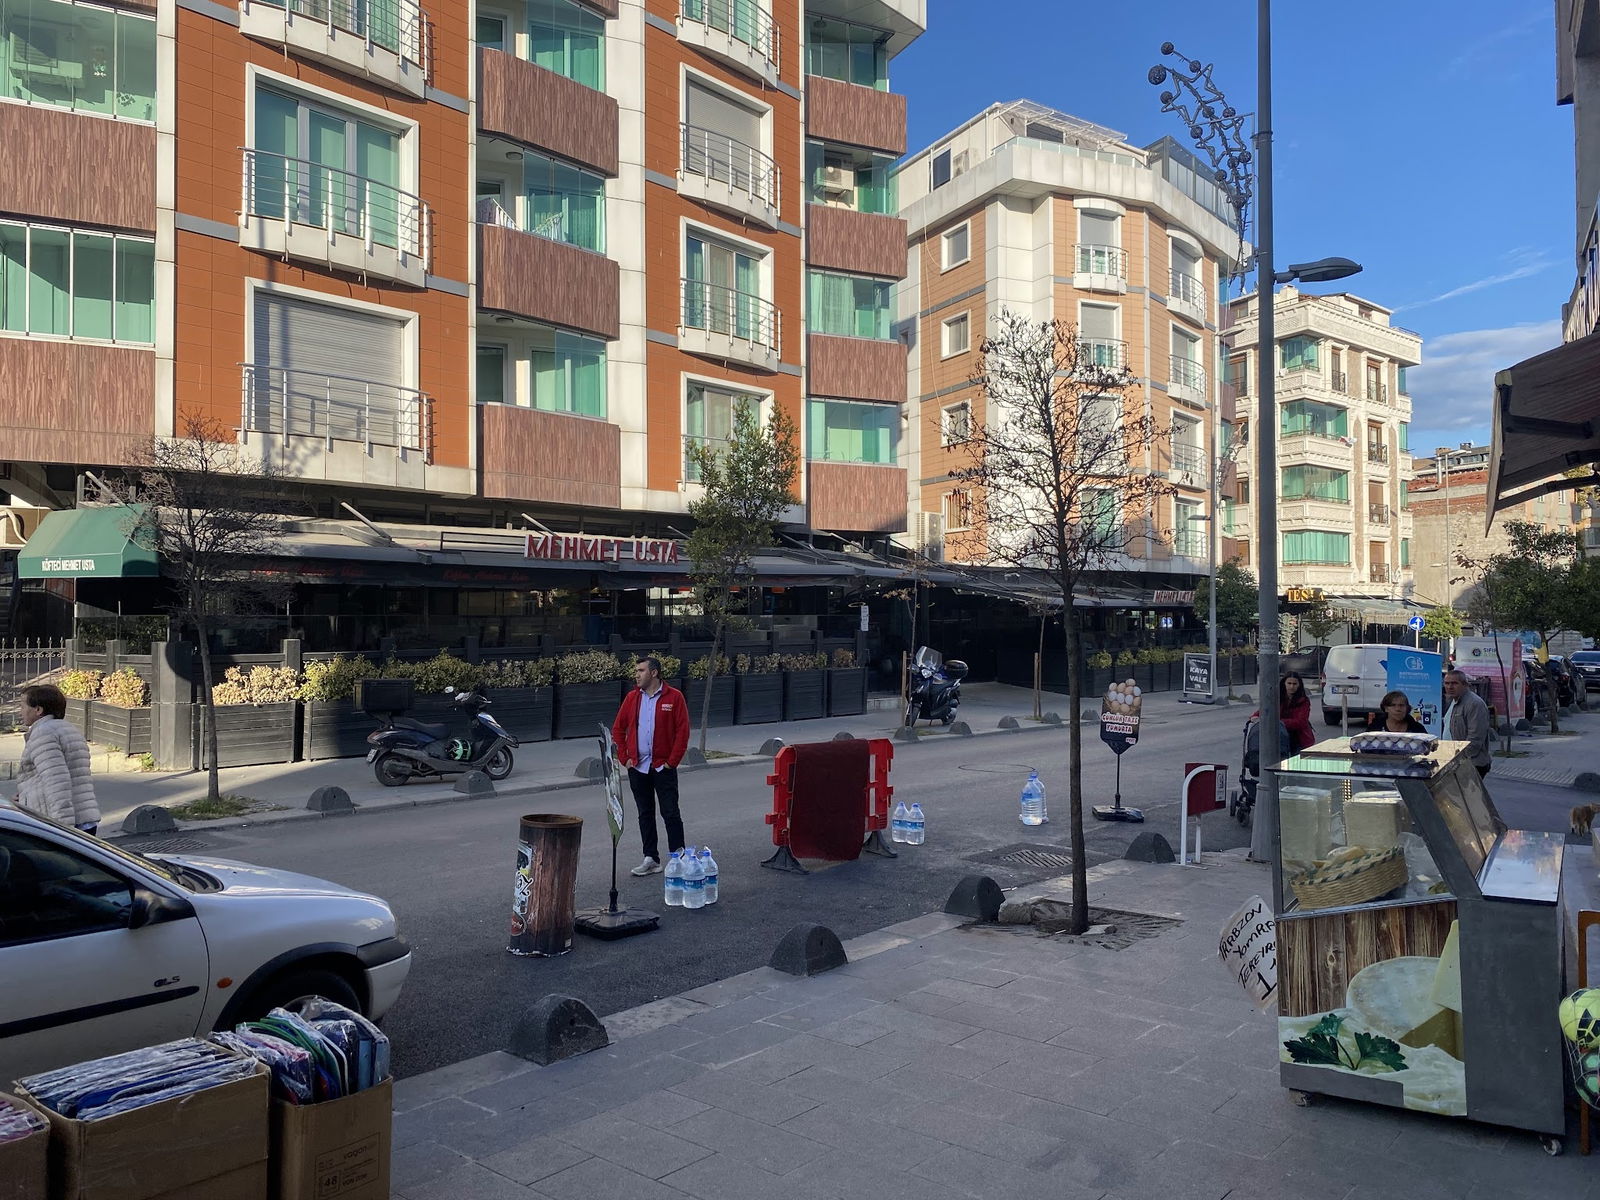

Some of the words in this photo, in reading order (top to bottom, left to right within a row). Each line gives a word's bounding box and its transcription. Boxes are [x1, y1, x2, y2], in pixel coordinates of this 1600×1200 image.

[524, 534, 625, 562] MEHMET
[633, 540, 679, 564] USTA
[62, 559, 81, 571] MEHMET
[82, 559, 96, 571] USTA
[1190, 666, 1208, 675] KAYA
[1189, 674, 1207, 684] VALE
